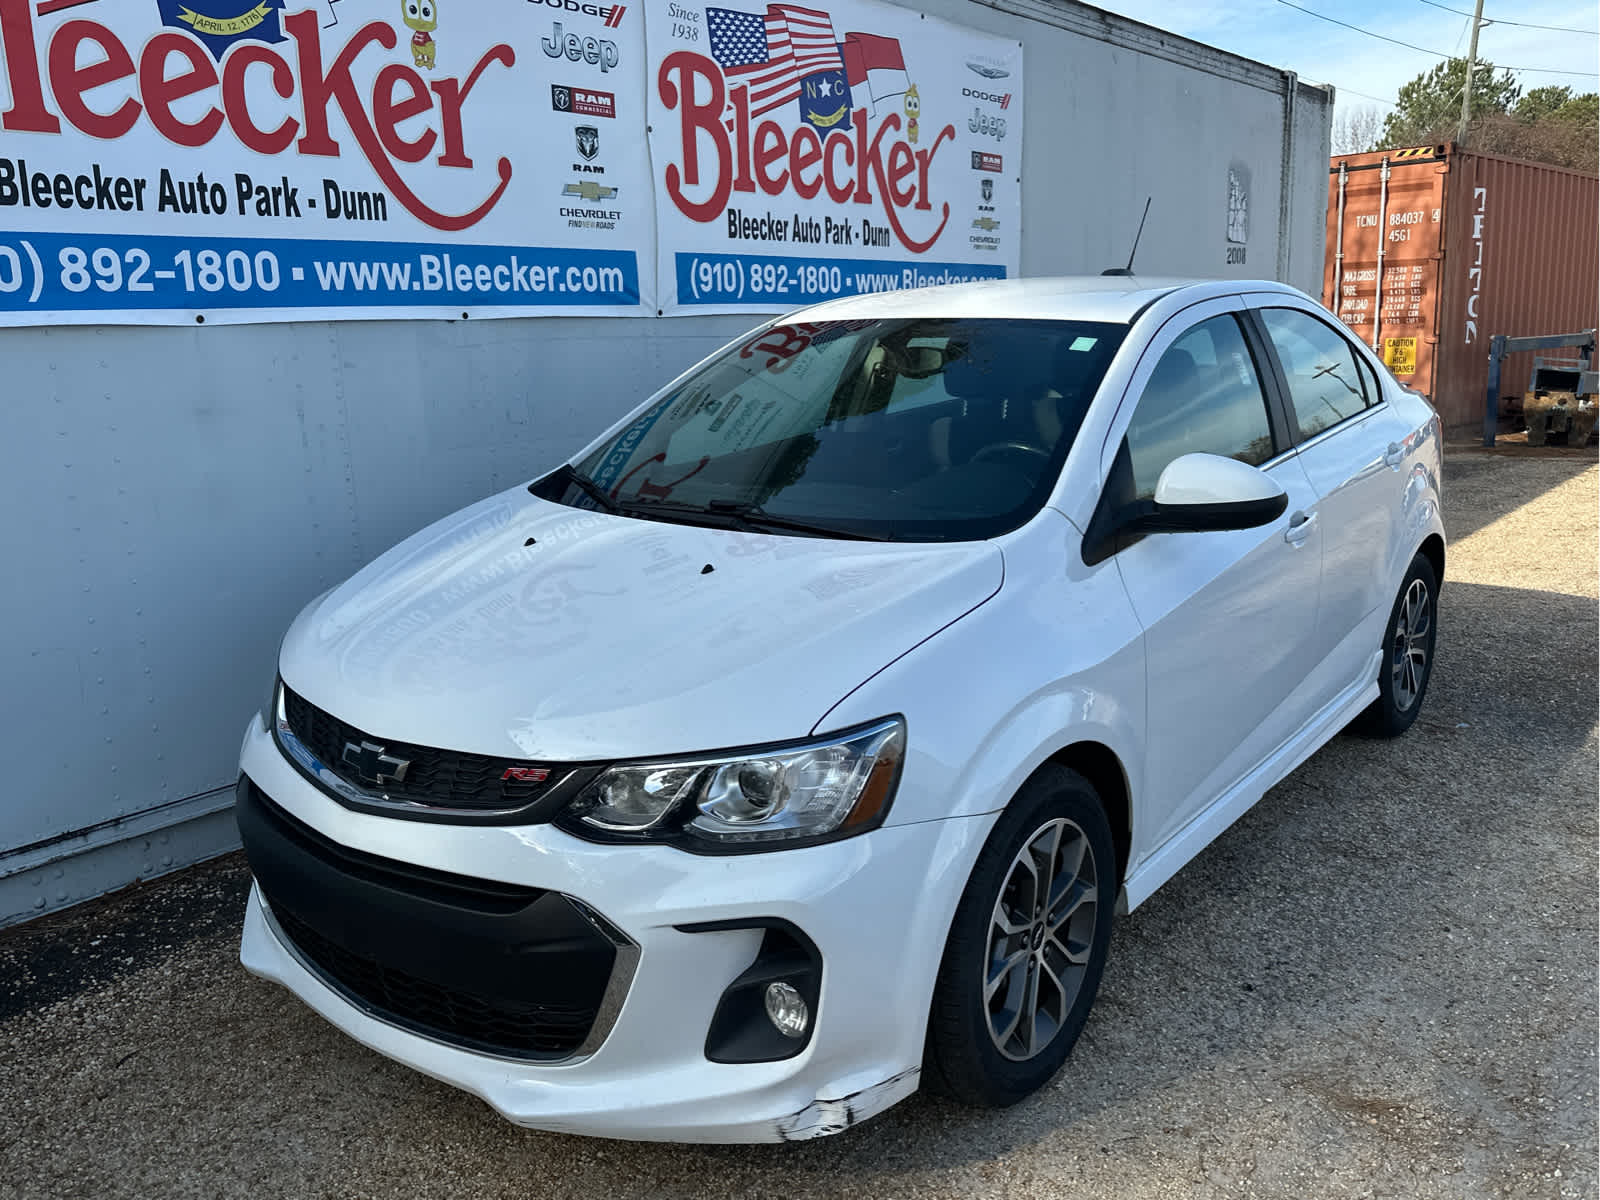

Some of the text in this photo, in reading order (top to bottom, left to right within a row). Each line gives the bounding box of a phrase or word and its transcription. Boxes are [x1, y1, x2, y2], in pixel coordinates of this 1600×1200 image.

[196, 18, 225, 32] APRIL
[241, 12, 260, 27] 1776
[668, 3, 700, 22] Since
[671, 23, 699, 42] 1938
[541, 21, 619, 73] Jeep
[806, 79, 845, 99] N C
[962, 87, 1004, 104] DODGE
[575, 93, 611, 106] RAM
[968, 107, 1007, 142] Jeep
[658, 50, 955, 253] Bleecker
[573, 163, 605, 174] RAM
[0, 158, 387, 221] Bleecker Auto Park Dunn
[559, 207, 622, 220] CHEVROLET
[1356, 214, 1378, 228] TCNU
[1389, 210, 1425, 226] 884037
[727, 208, 890, 247] Bleecker Auto Park Dunn
[1388, 228, 1412, 242] 45G1
[58, 246, 280, 293] 892-1800
[313, 253, 624, 294] www.Bleecker.com
[690, 257, 745, 299] (910)
[750, 263, 841, 294] 892-1800
[1387, 338, 1414, 348] CAUTION
[1392, 356, 1407, 364] HIGH
[500, 767, 552, 782] RS
